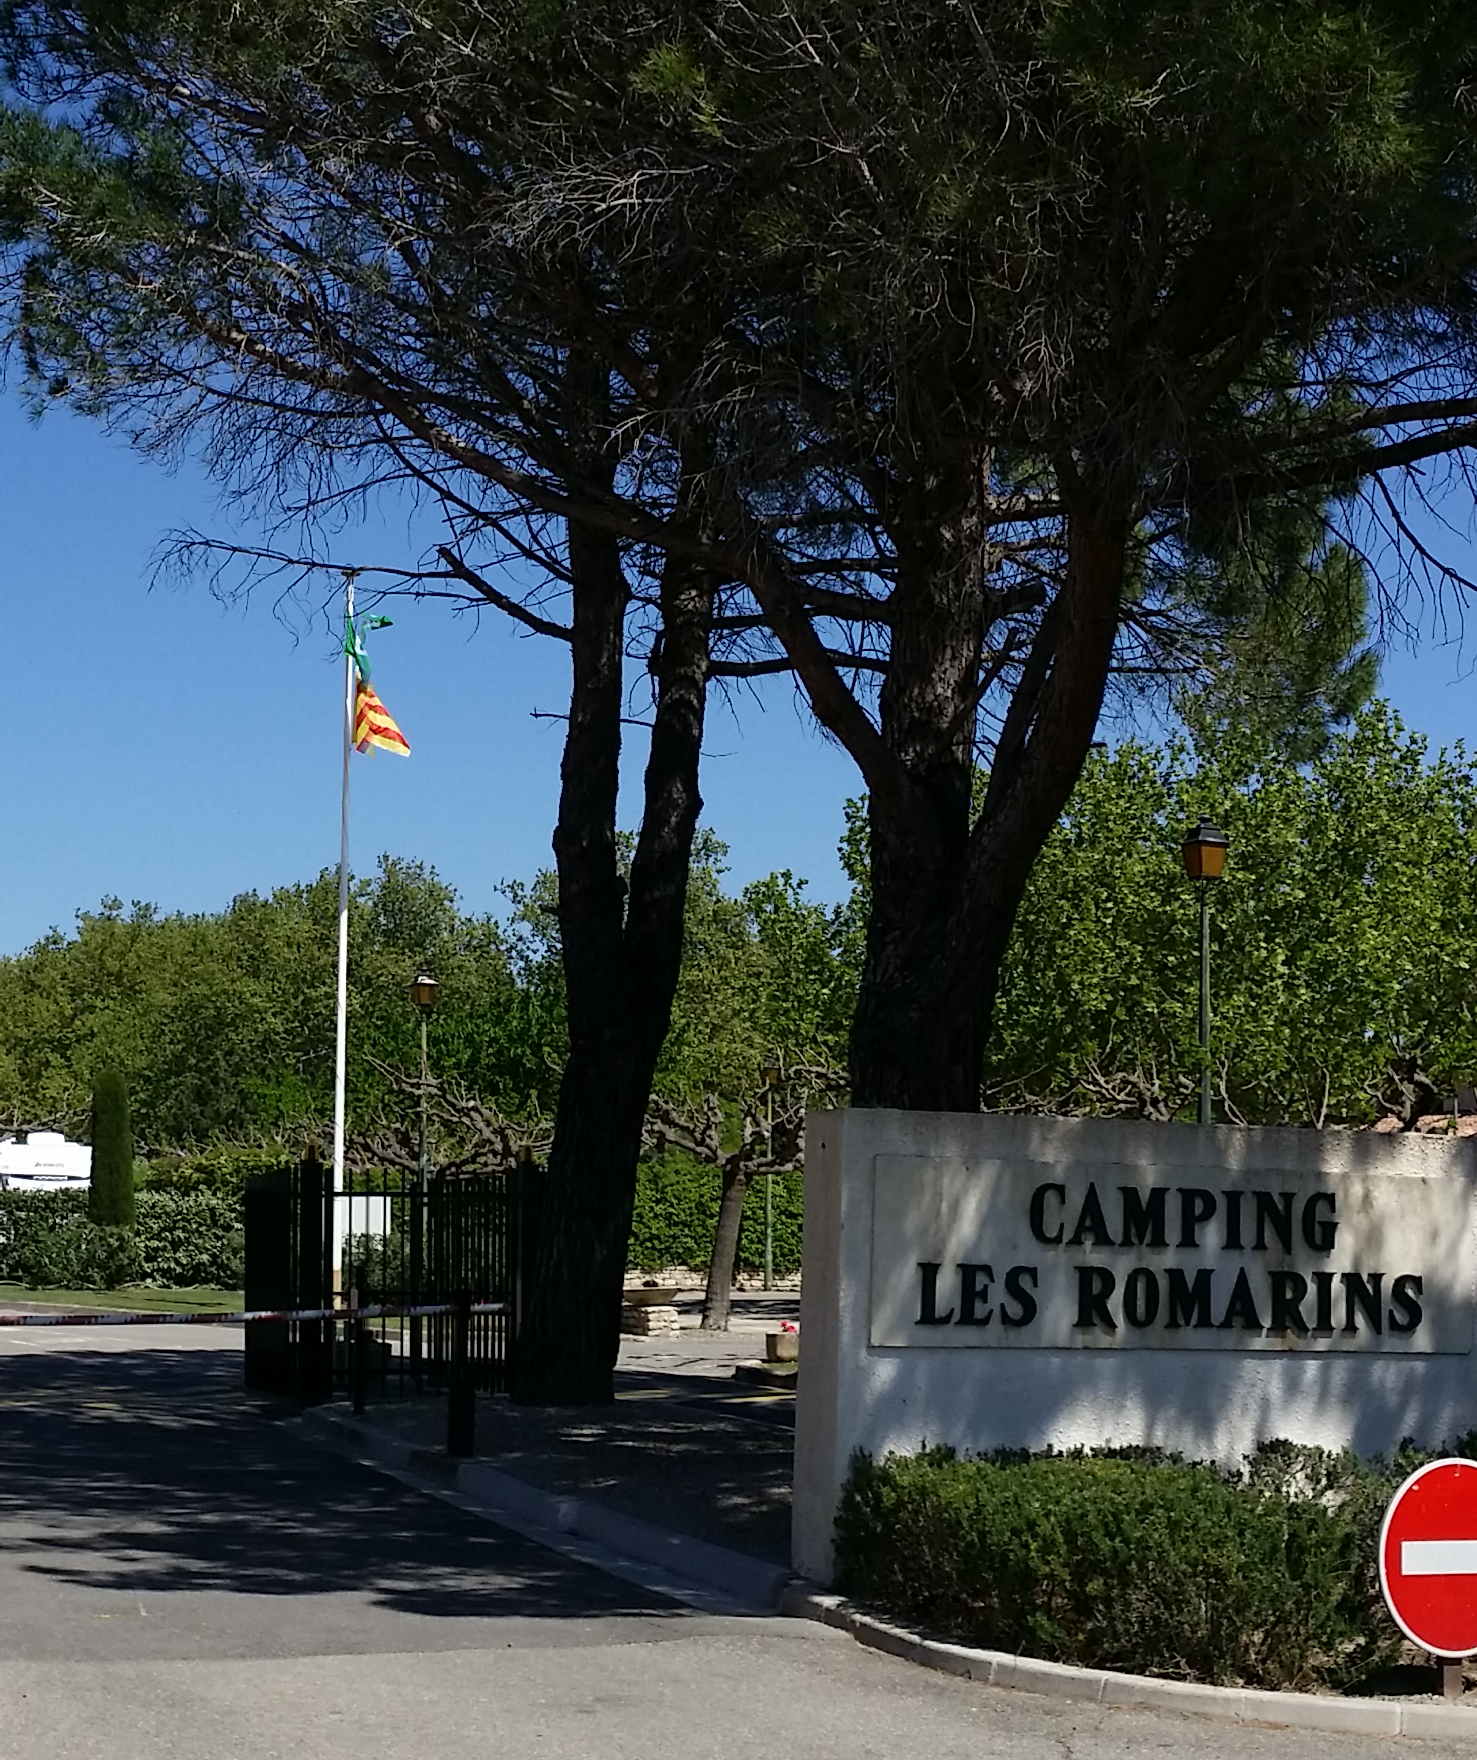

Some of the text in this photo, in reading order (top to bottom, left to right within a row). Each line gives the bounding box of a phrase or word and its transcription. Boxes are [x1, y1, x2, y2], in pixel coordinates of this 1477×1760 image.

[1029, 1181, 1340, 1256] CAMPING
[914, 1261, 1424, 1335] LES ROMARINS
